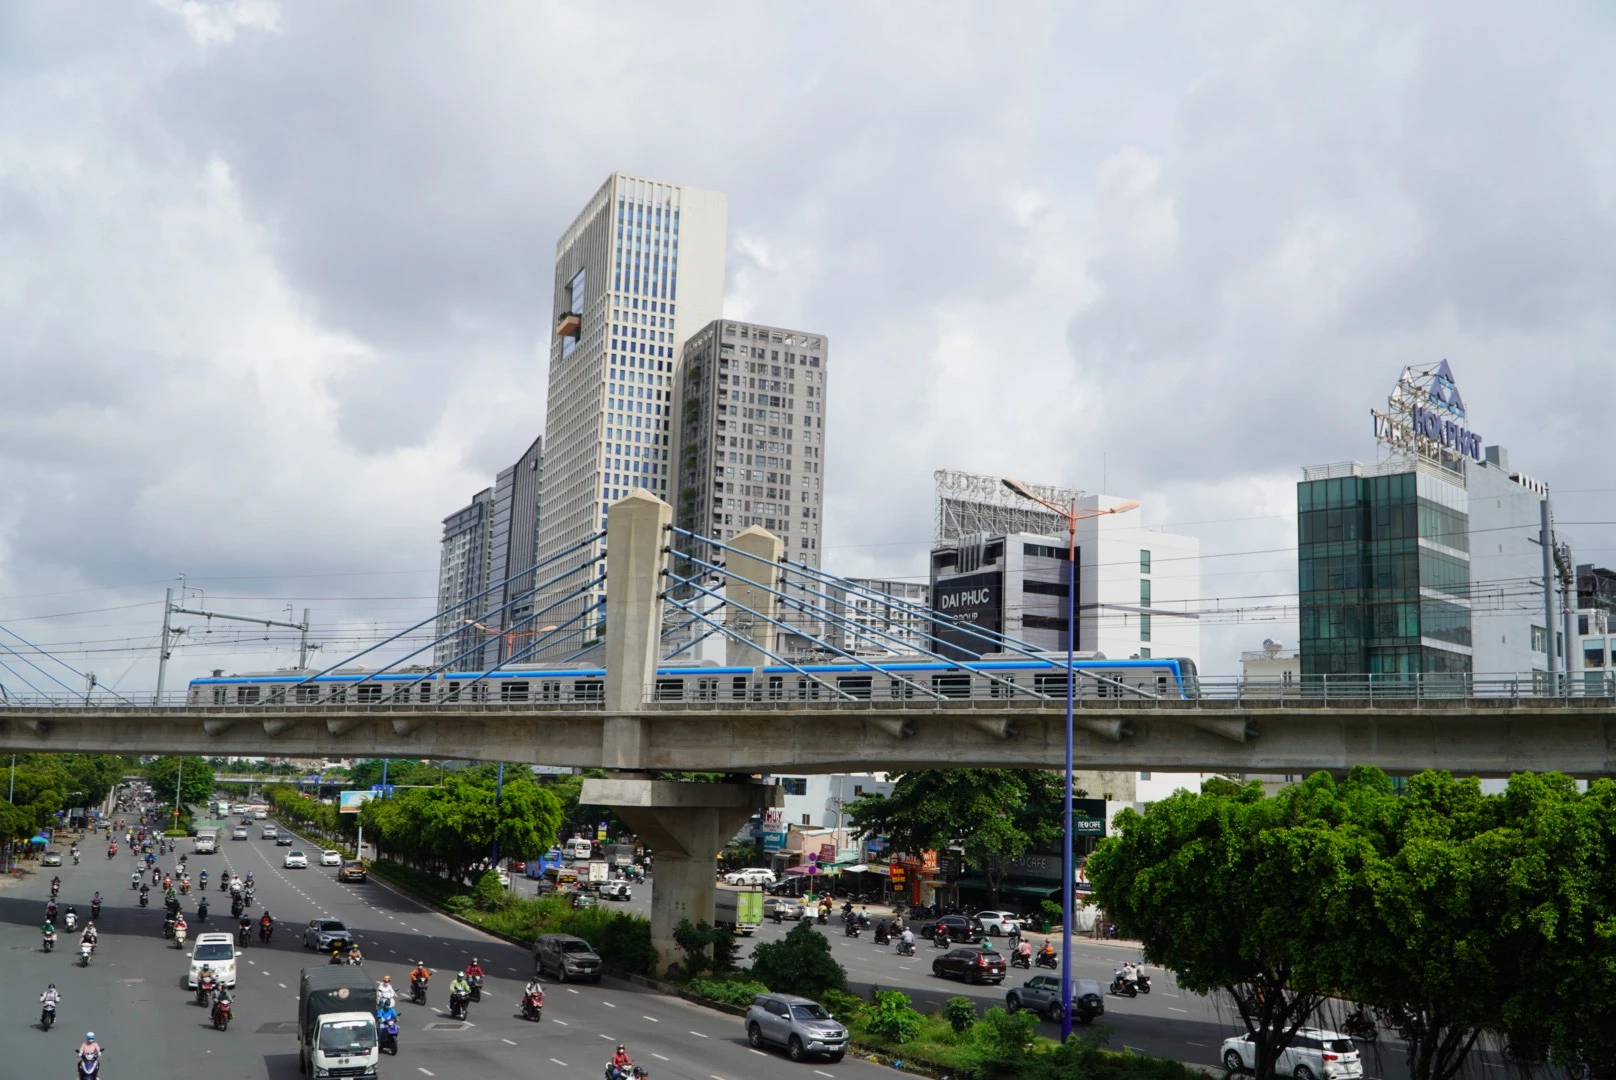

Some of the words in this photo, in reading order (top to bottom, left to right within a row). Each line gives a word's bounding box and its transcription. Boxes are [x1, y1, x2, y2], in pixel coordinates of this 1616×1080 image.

[942, 593, 960, 610] DAI
[961, 588, 990, 606] PHUC
[1089, 821, 1101, 829] CAFE
[1026, 857, 1047, 869] CAFE
